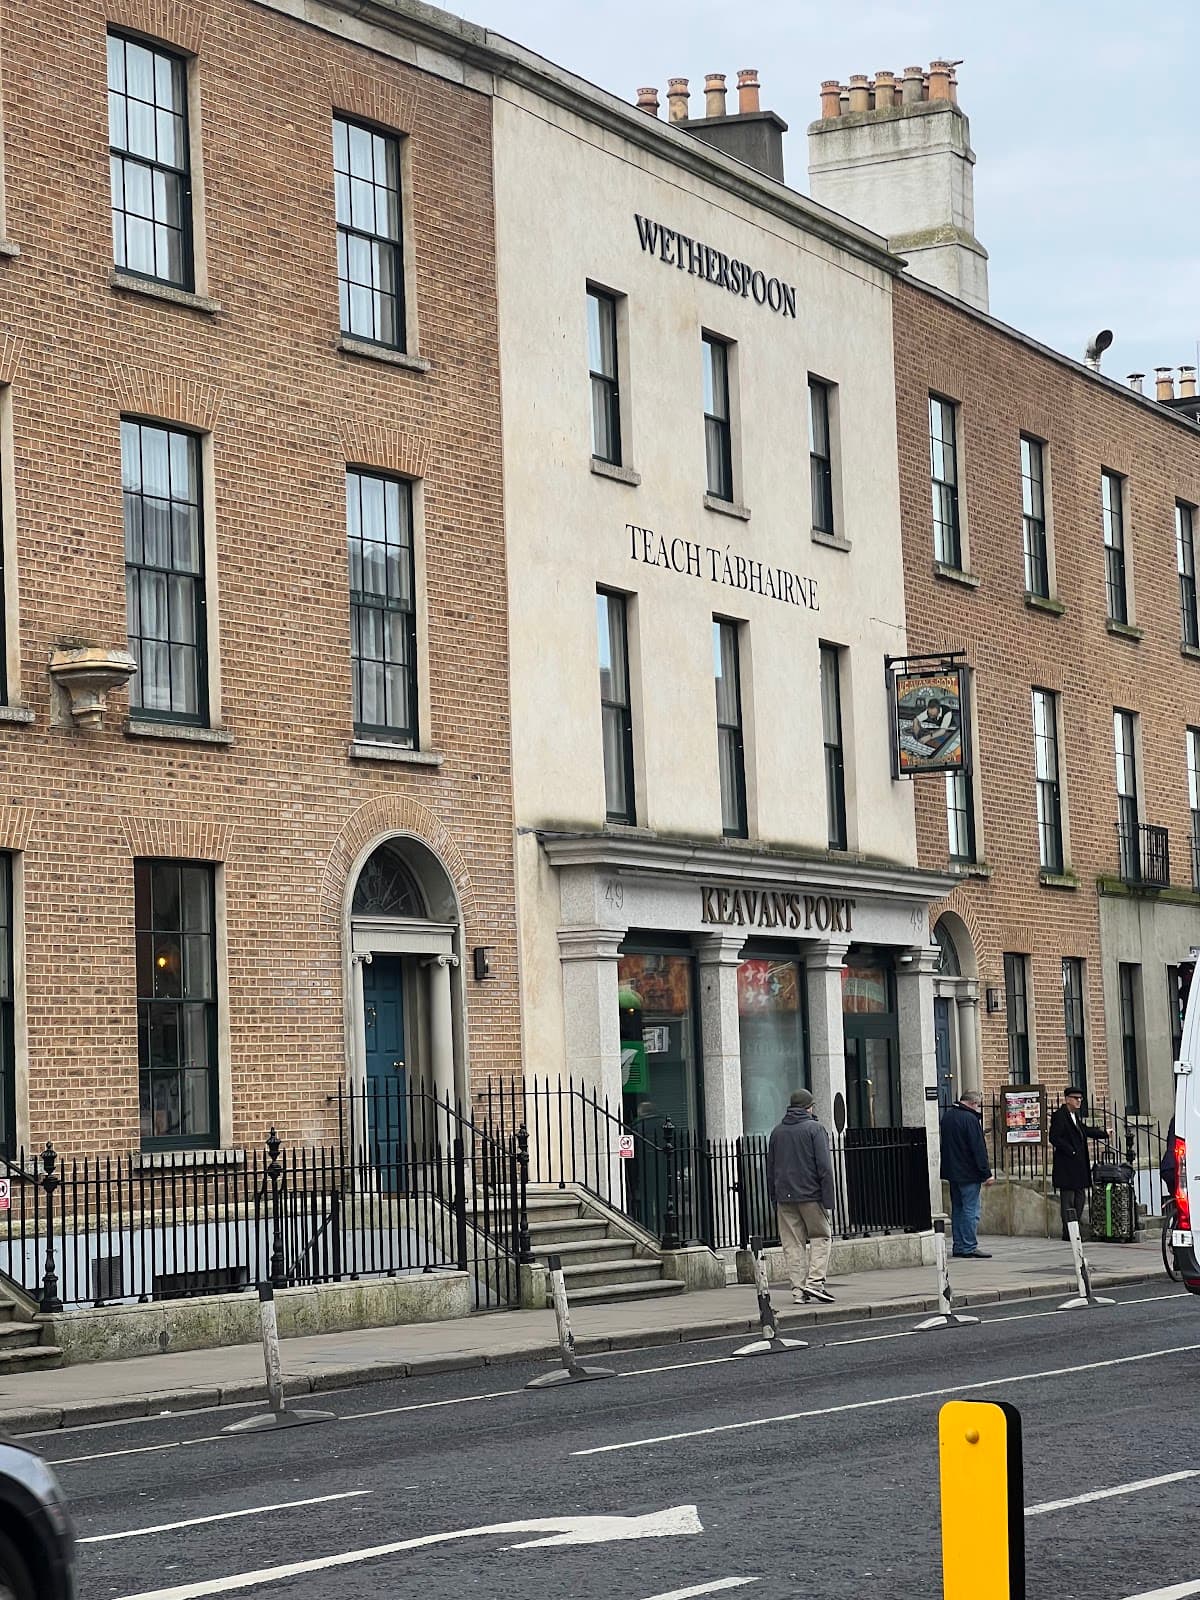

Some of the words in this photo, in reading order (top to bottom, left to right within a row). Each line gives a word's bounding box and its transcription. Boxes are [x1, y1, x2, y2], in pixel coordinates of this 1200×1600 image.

[634, 213, 797, 319] WETHERSPOON
[625, 523, 702, 578] TEACH
[706, 544, 820, 611] TÁBHAIRNE
[605, 880, 624, 911] 49
[700, 886, 801, 930] KEAVAN'S
[803, 895, 857, 933] PORT
[910, 907, 923, 932] 49
